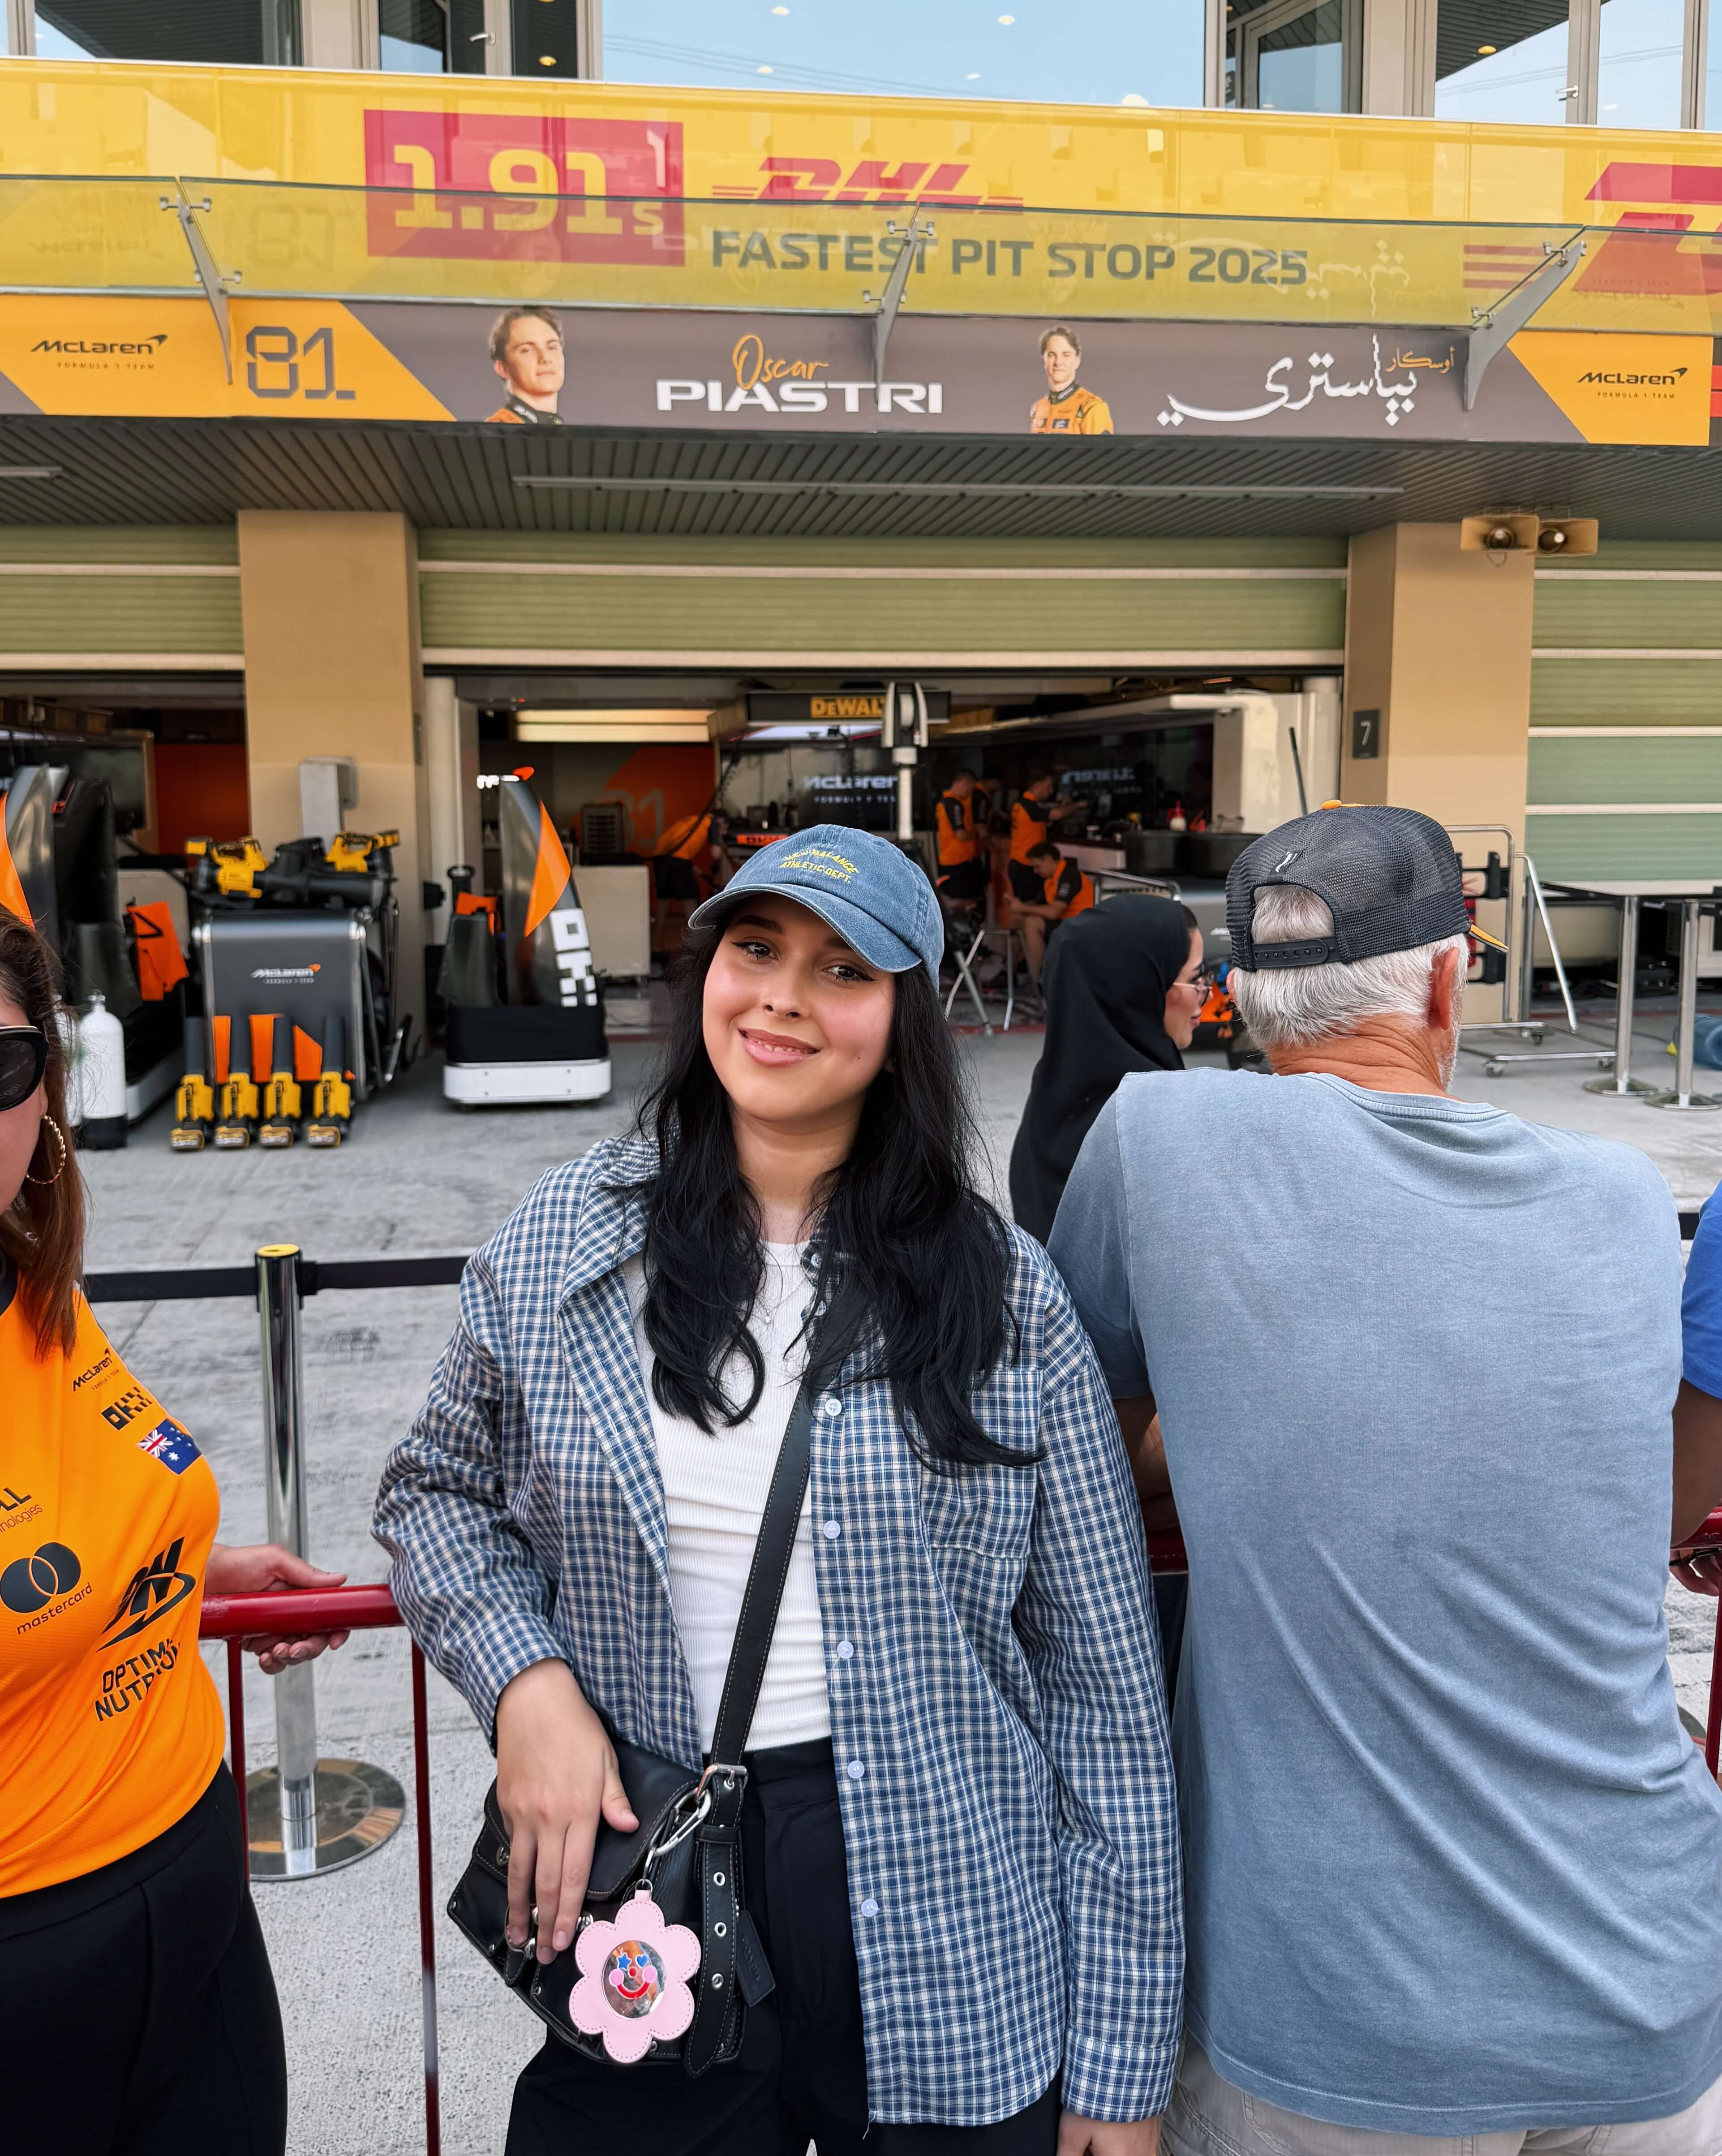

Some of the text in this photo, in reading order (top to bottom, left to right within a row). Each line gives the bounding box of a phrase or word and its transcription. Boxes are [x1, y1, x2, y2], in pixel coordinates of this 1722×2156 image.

[753, 156, 983, 215] DHL
[712, 230, 1307, 285] FASTEST PIT STOP 2025
[29, 340, 154, 355] McLaren
[246, 325, 356, 400] 81
[732, 333, 829, 391] Oscar
[656, 379, 943, 414] PIASTRI
[1576, 372, 1675, 386] McLaren
[1360, 720, 1373, 747] 7
[780, 860, 852, 883] ATHLETIC DEPT.
[811, 849, 859, 874] BALANCE
[73, 1356, 113, 1392] McLaren
[101, 1386, 153, 1431] OKX
[0, 1487, 32, 1511] LL
[0, 1504, 43, 1533] nologies
[17, 1582, 93, 1635] mastercard
[102, 1638, 173, 1694] OPTIM
